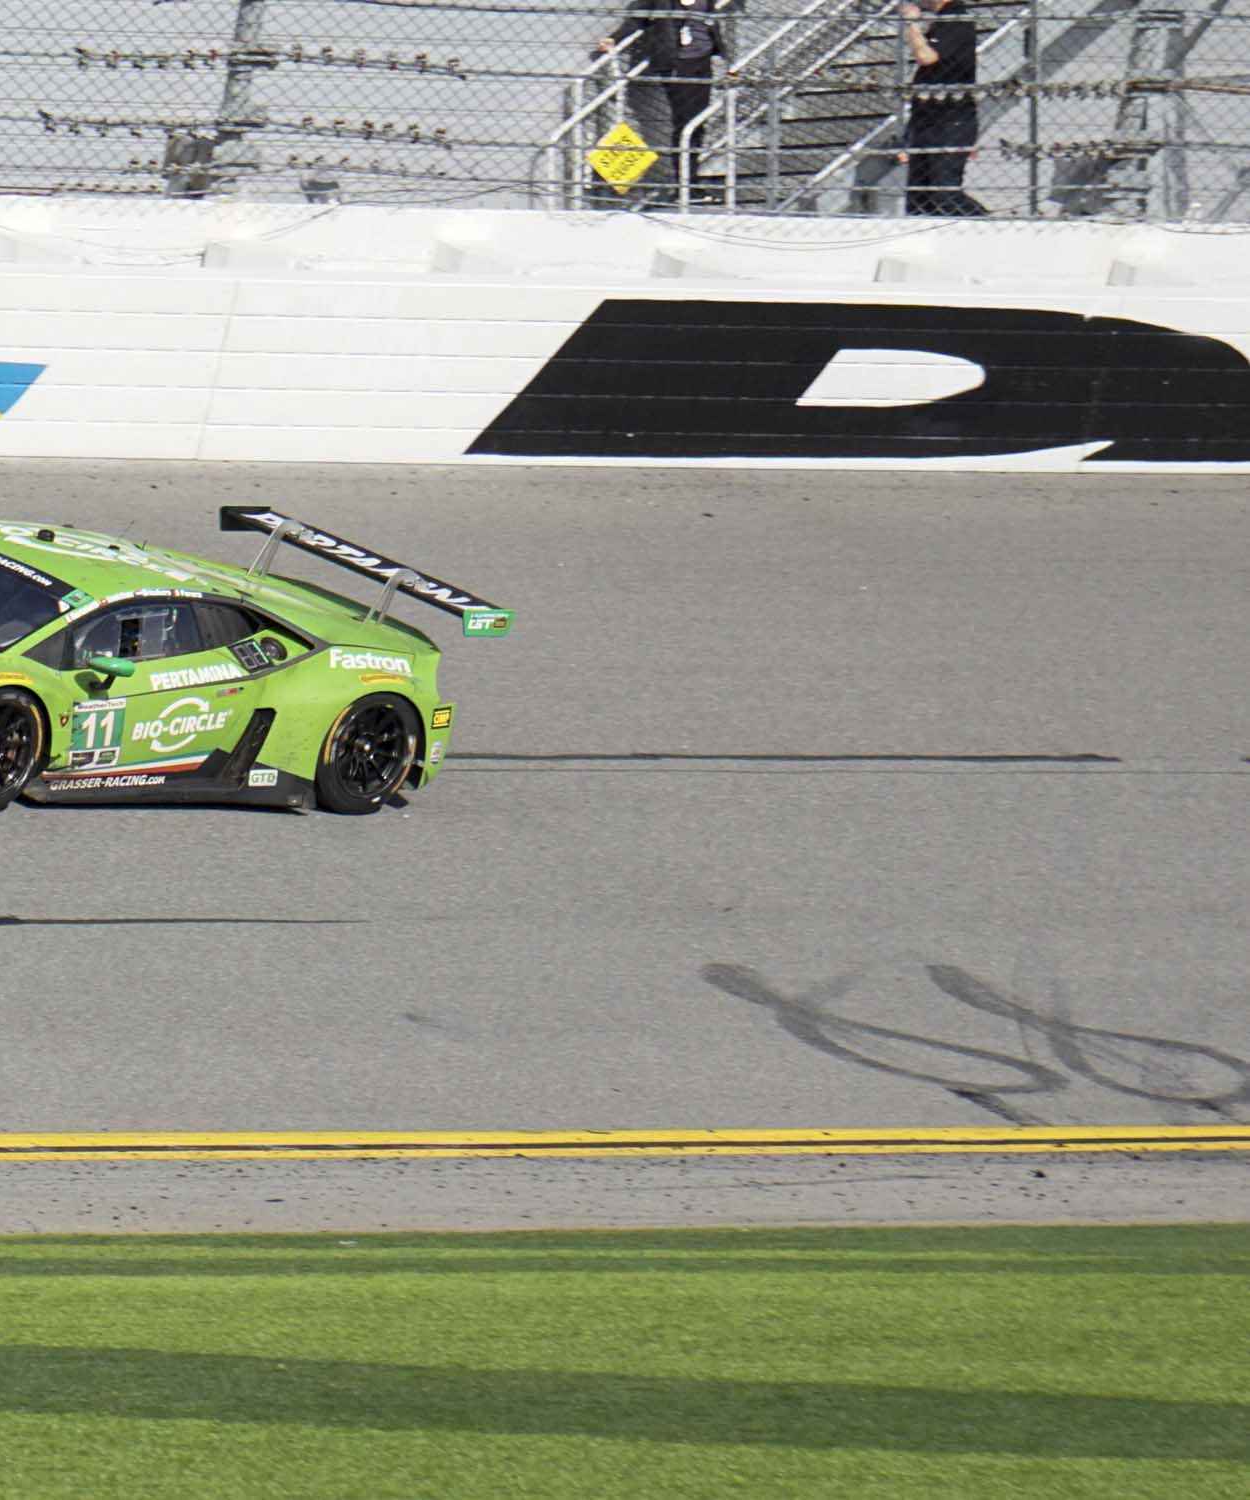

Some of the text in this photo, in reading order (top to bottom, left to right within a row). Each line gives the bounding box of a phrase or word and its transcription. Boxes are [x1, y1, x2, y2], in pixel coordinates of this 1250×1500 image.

[150, 662, 243, 691] PERTAMINA
[329, 648, 414, 677] Fastron
[81, 710, 115, 748] 11
[131, 711, 228, 741] BIO-CIRCLE
[252, 773, 276, 783] GTD
